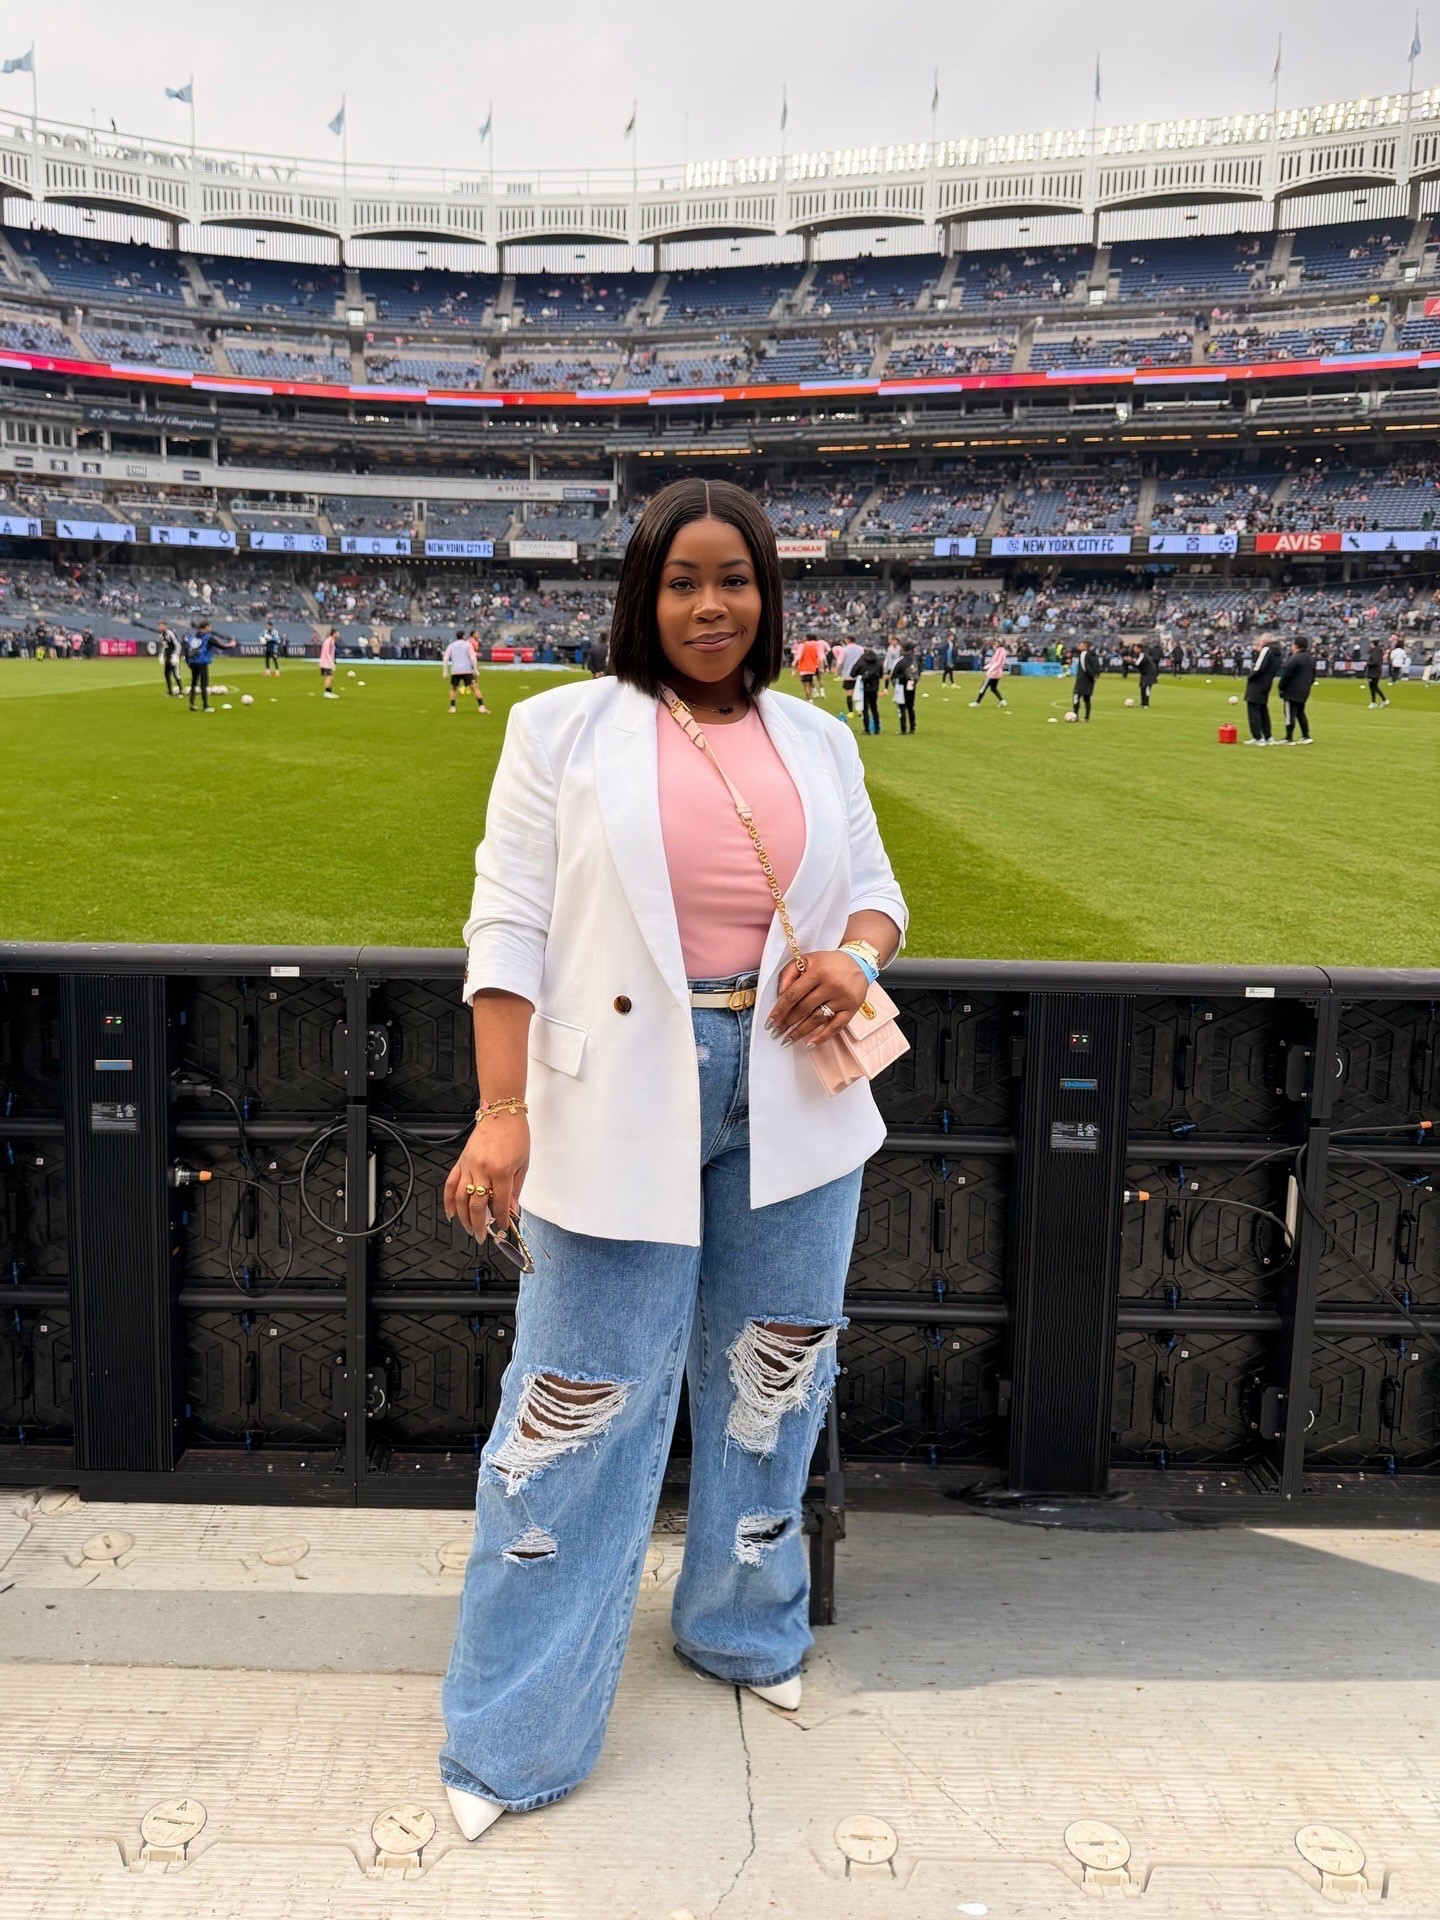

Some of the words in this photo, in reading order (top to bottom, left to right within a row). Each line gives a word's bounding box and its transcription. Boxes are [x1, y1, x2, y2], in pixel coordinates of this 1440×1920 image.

[428, 542, 444, 552] NEW
[446, 543, 464, 553] YORK
[467, 544, 482, 553] CITY
[483, 544, 492, 553] FC
[1022, 539, 1044, 552] NEW
[1048, 539, 1075, 552] YORK
[1077, 539, 1099, 551] CITY
[1101, 538, 1115, 551] FC
[1274, 534, 1322, 551] AVIS
